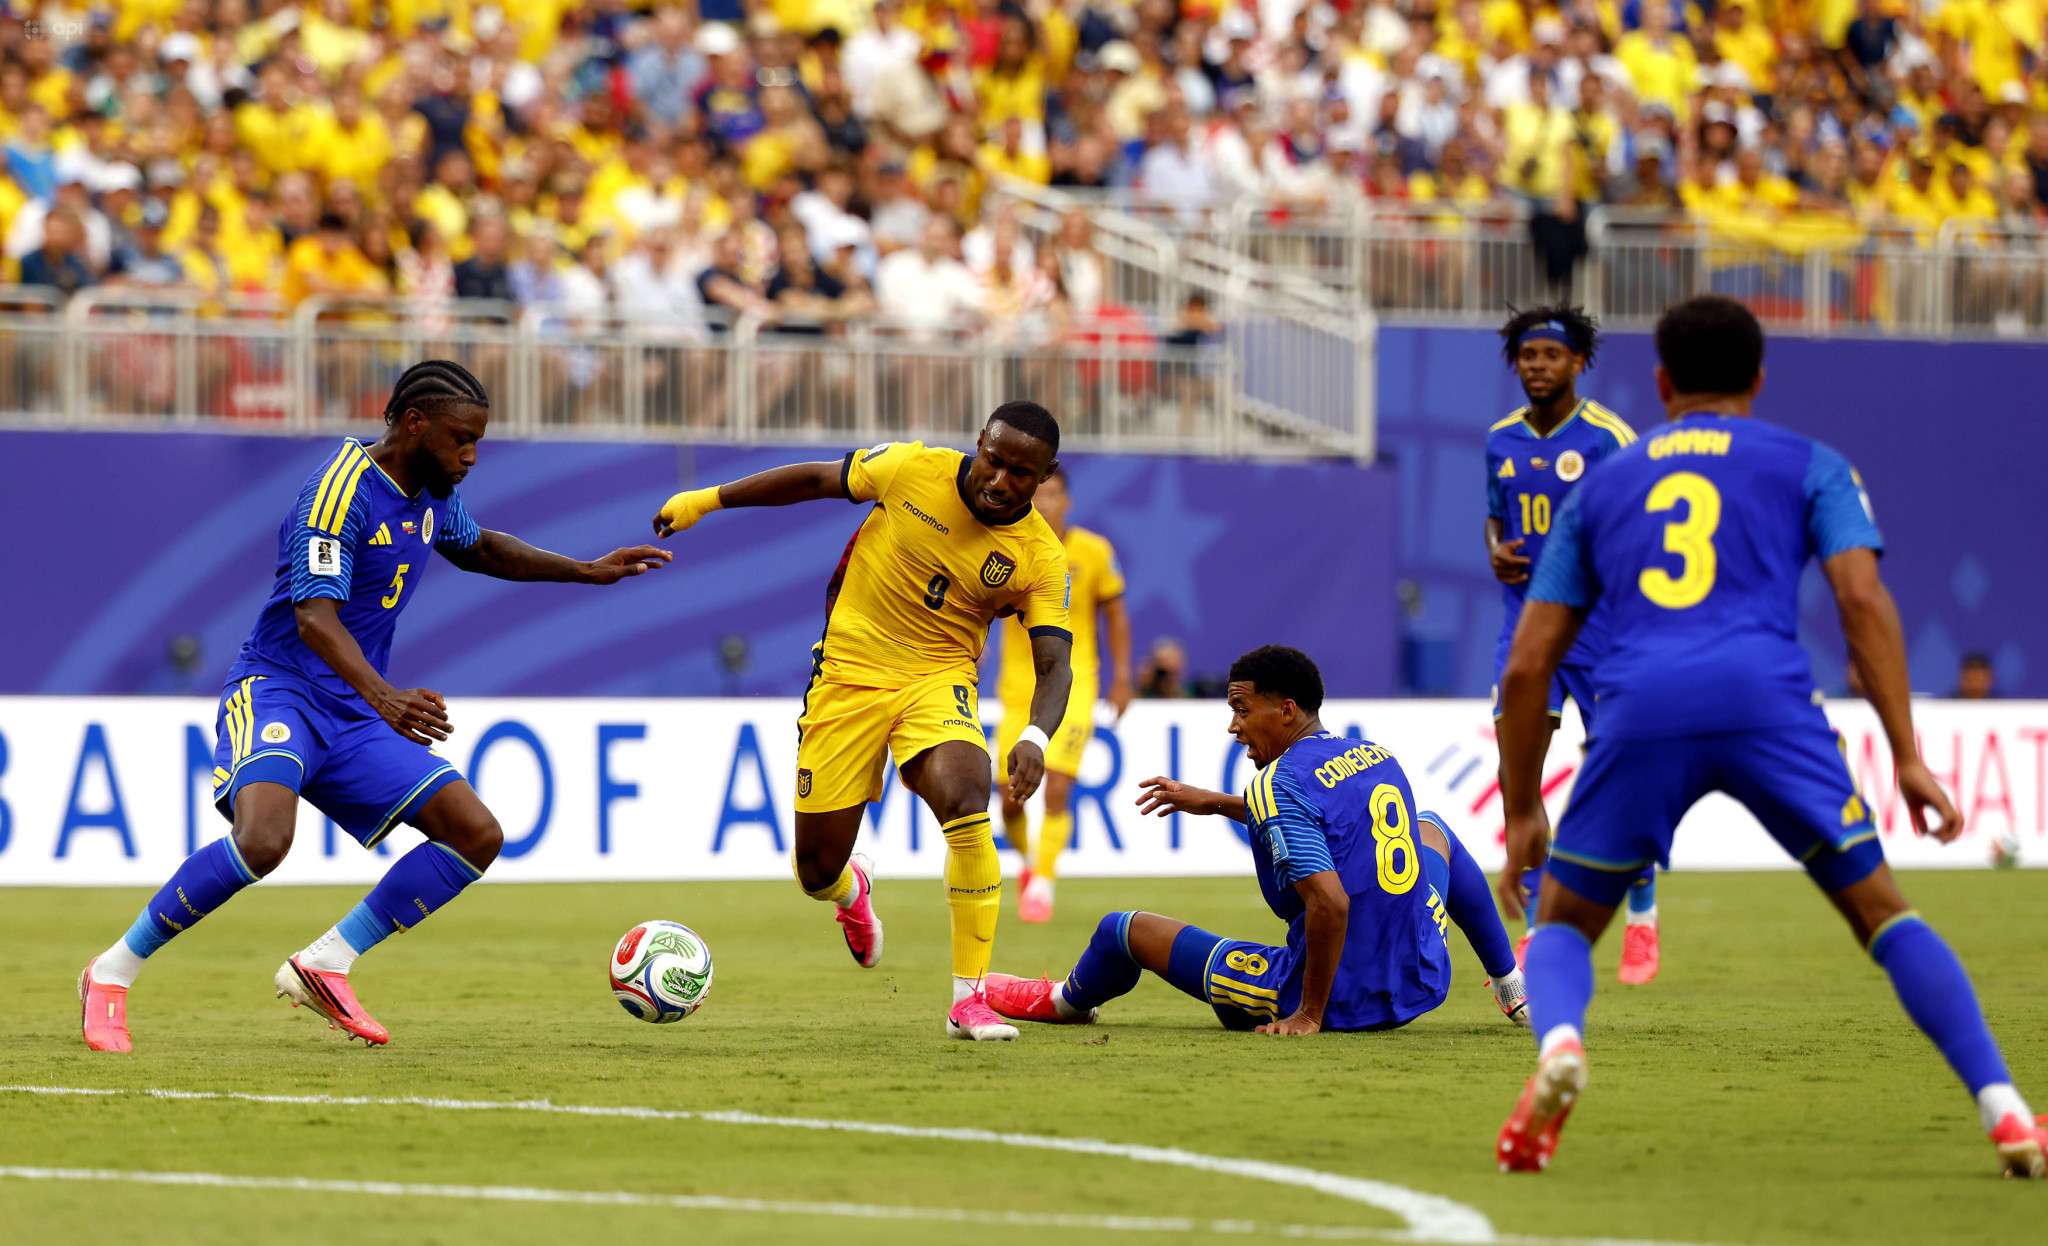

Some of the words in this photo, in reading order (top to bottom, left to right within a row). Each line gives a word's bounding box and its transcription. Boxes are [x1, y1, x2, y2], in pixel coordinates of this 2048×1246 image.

[902, 500, 950, 535] marathon
[1518, 493, 1551, 535] 10
[1638, 471, 1721, 610] 3
[381, 564, 410, 609] 5
[923, 574, 951, 610] 9
[952, 685, 973, 719] 9
[468, 720, 647, 859] OF
[1369, 783, 1420, 895] 8
[1225, 950, 1269, 976] 8
